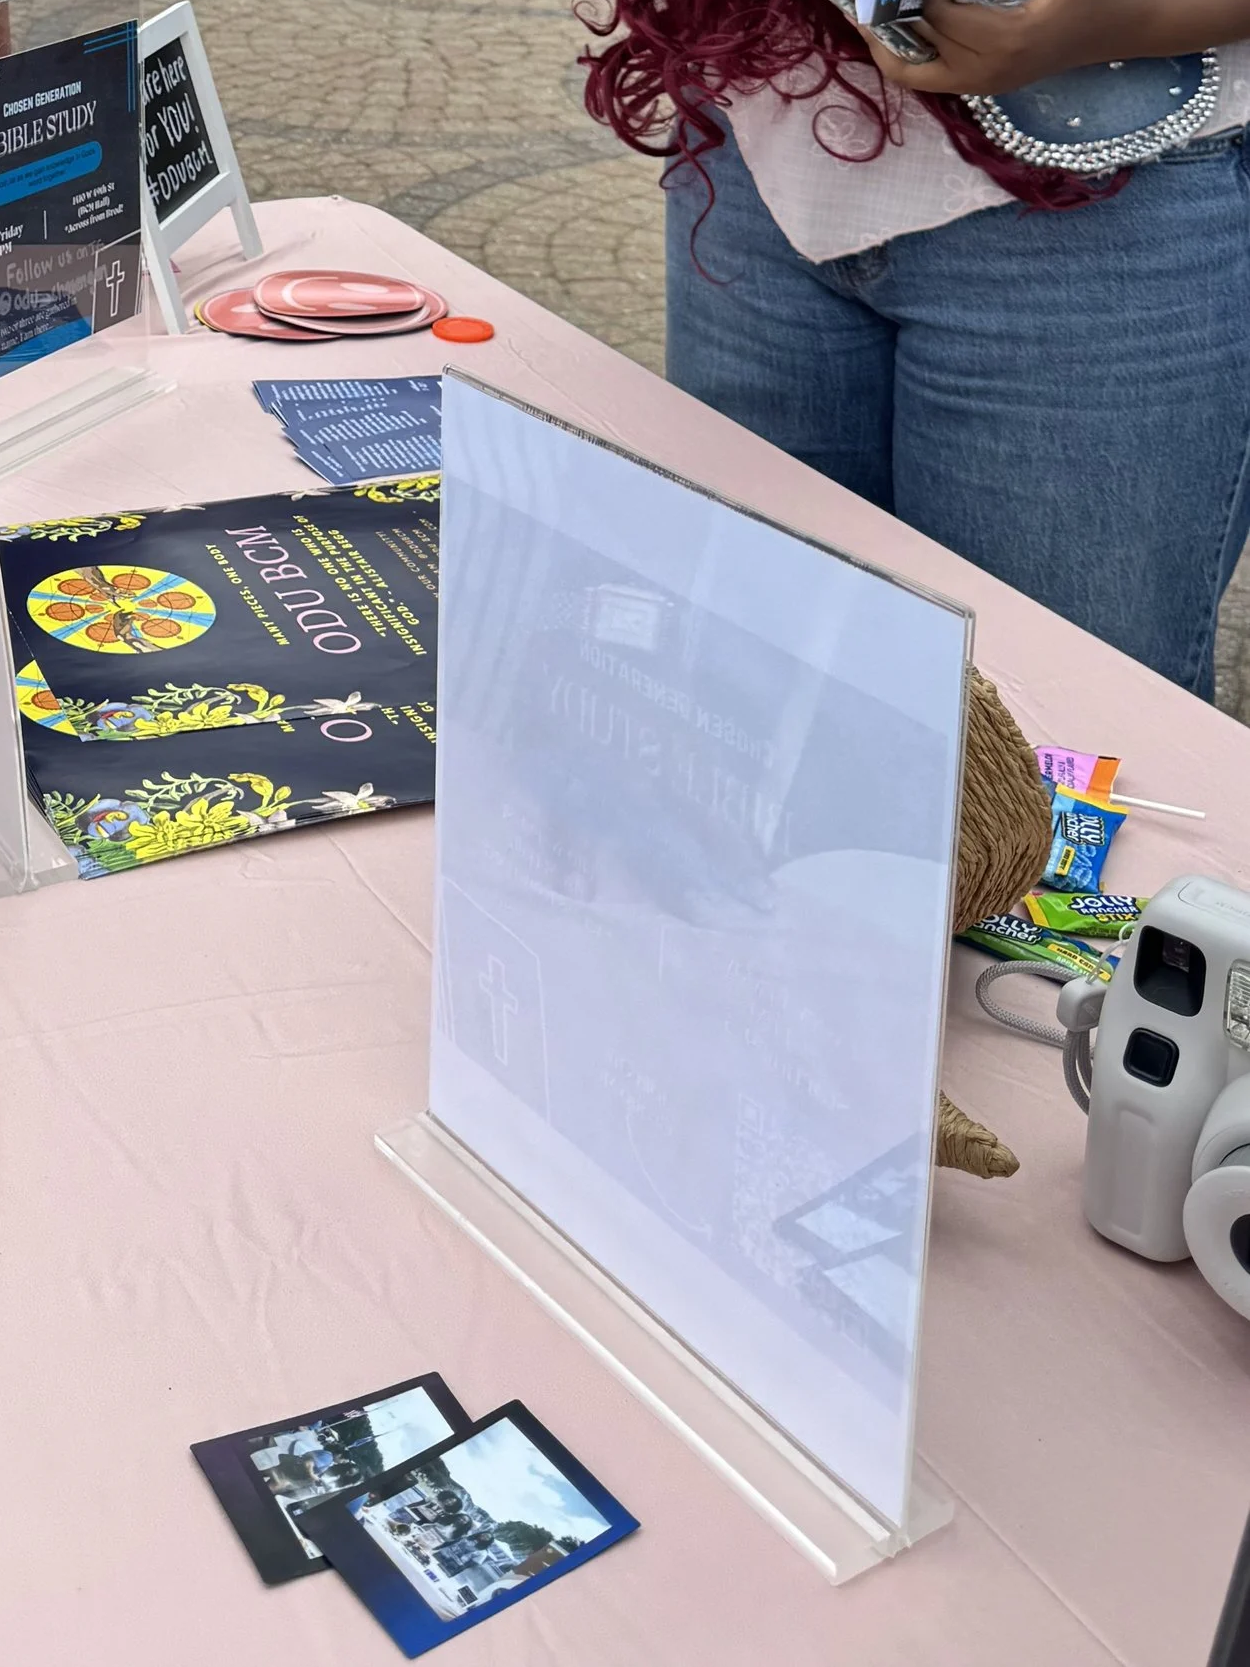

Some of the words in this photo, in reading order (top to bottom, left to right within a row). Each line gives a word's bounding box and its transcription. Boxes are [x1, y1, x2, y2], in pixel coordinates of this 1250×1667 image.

[158, 56, 186, 93] here
[3, 98, 33, 118] CHOSEN
[35, 81, 81, 108] GENERATION
[46, 100, 97, 140] STUDY
[157, 92, 200, 147] YOU!
[6, 256, 53, 290] Follow
[57, 249, 72, 268] us
[291, 528, 305, 536] IS
[303, 524, 341, 555] PURPOSE
[328, 529, 353, 549] BEGG
[206, 543, 230, 567] BODY
[225, 525, 308, 584] BCM
[300, 537, 322, 556] WHO
[318, 557, 339, 575] ONE
[335, 557, 355, 573] THE
[348, 550, 388, 588] ALISTAIR
[222, 567, 242, 584] ONE
[334, 577, 353, 591] NO
[350, 574, 366, 585] IN
[239, 586, 269, 621] PIECES,
[347, 592, 362, 602] IS
[274, 589, 361, 654] ODU
[361, 587, 427, 655] INSIGNIFICANT
[262, 620, 290, 646] MANY
[1070, 895, 1133, 909] JOLLY
[1081, 905, 1139, 914] RANCHER
[981, 914, 1040, 934] OLLY
[1096, 912, 1136, 922] STIX
[973, 922, 1041, 942] ancher
[1056, 947, 1078, 960] HARD
